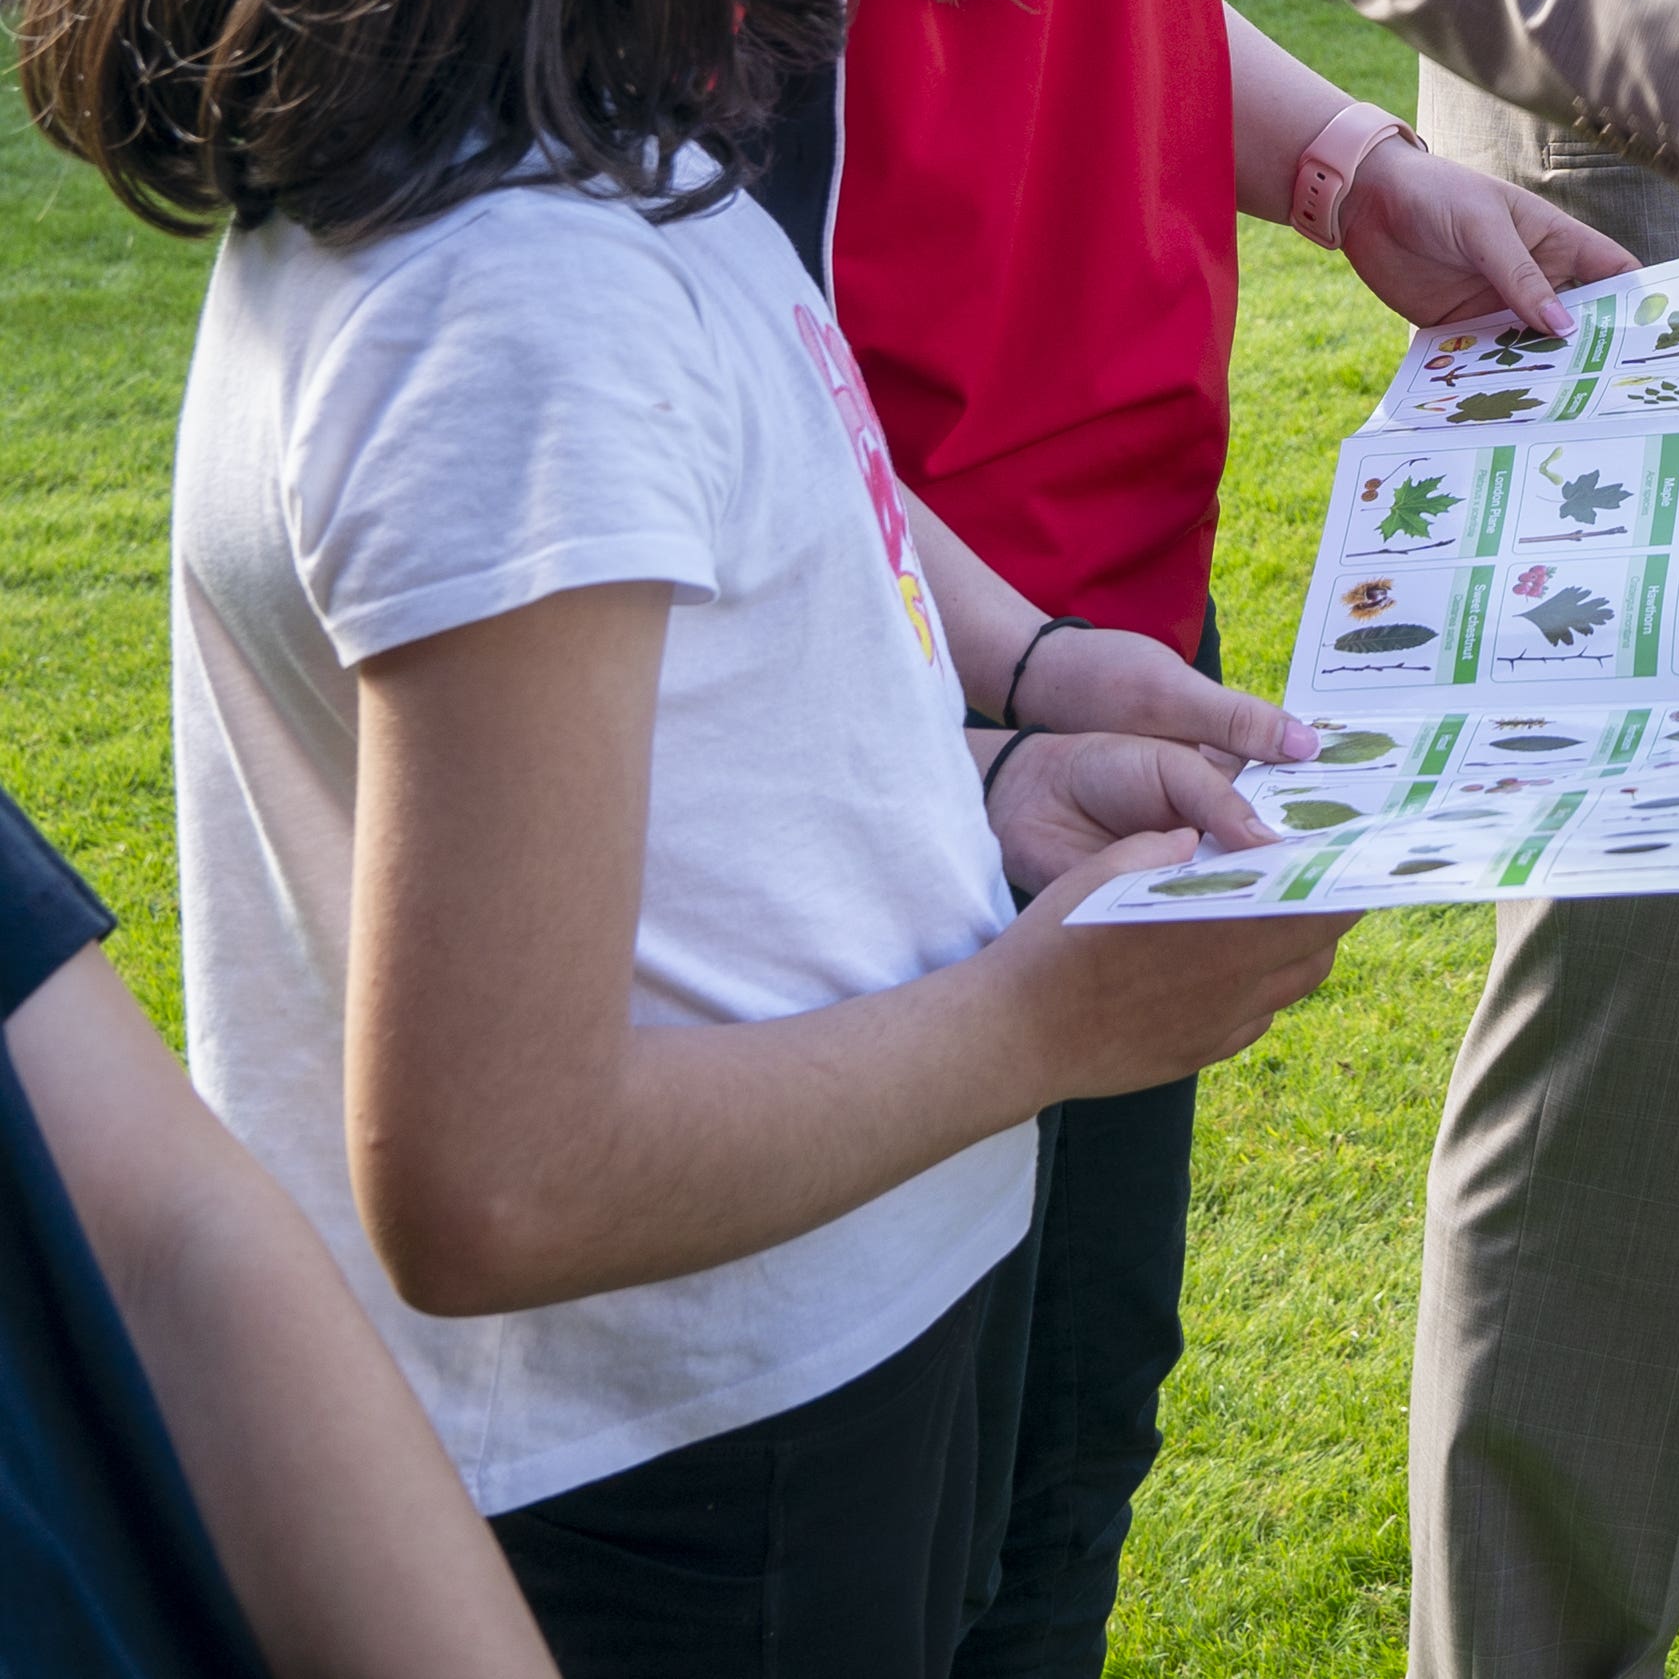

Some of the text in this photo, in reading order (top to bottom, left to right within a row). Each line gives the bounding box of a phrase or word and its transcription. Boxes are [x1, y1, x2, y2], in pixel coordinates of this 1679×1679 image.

[1486, 470, 1508, 534] London Plane
[1661, 477, 1676, 508] Maple
[1462, 584, 1487, 660] Sweet chestnut
[1643, 584, 1661, 636] Hawthorn
